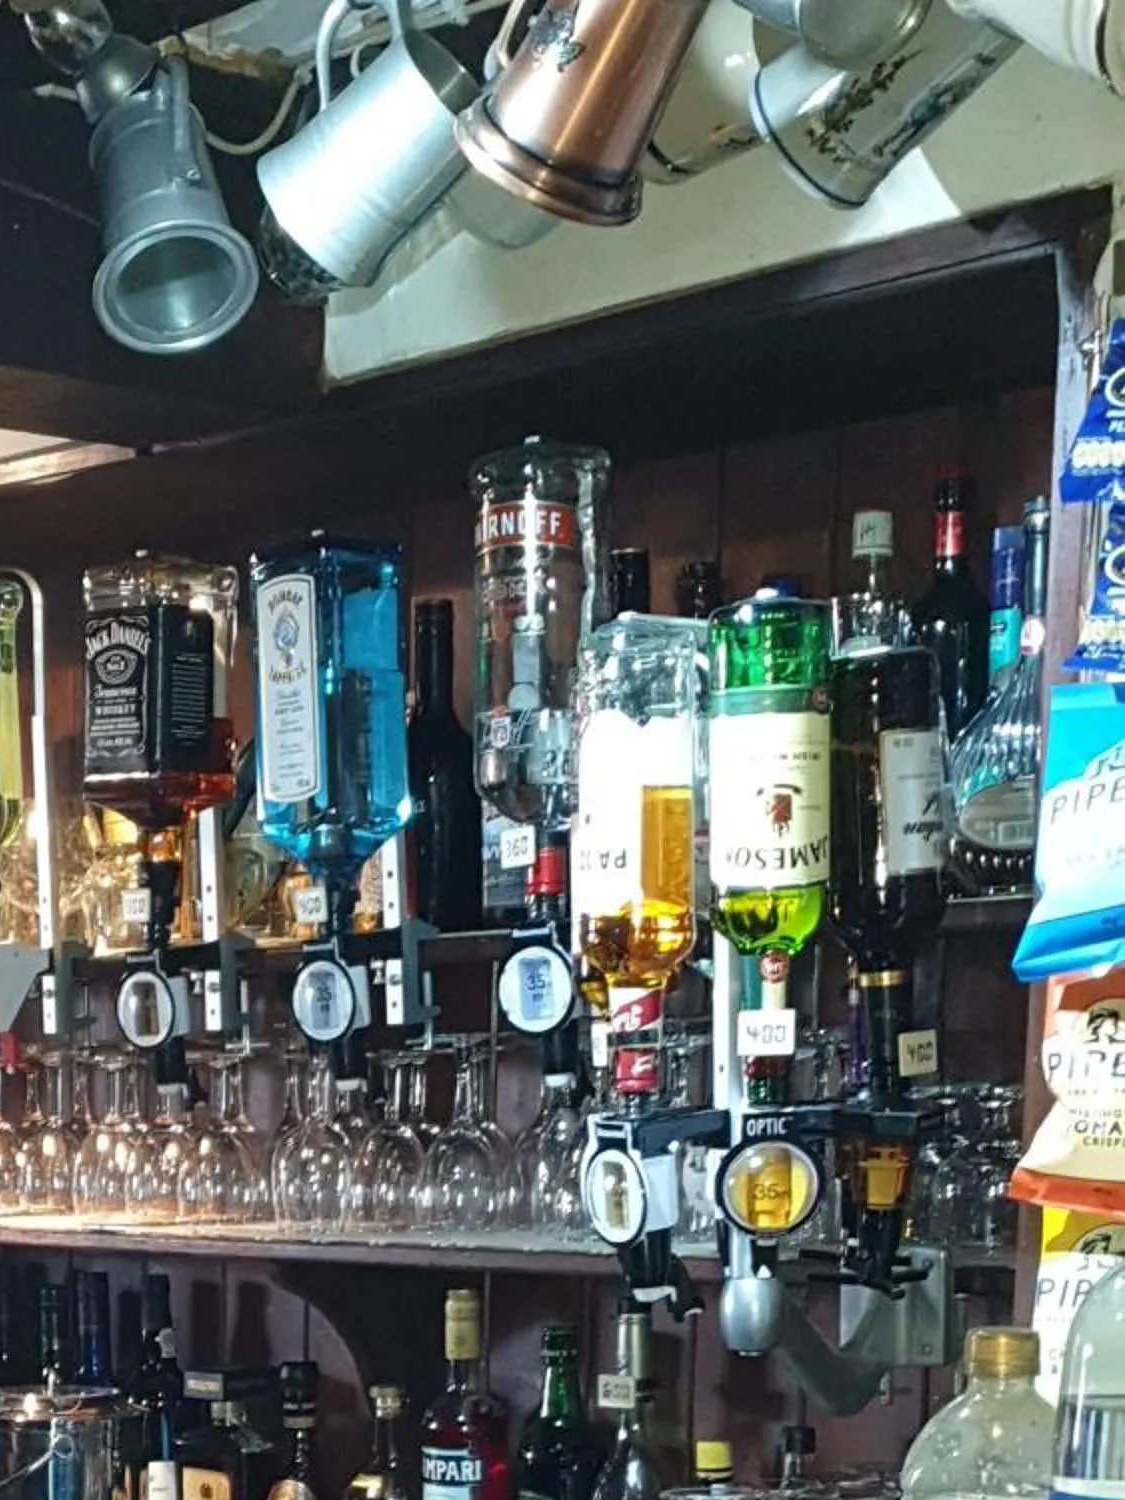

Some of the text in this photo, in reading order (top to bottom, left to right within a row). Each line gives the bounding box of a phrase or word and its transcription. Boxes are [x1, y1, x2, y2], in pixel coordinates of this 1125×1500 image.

[1050, 776, 1125, 825] PIPE
[1047, 1051, 1125, 1087] PIPE
[746, 1118, 789, 1136] OPTIC
[1036, 1277, 1093, 1309] PIP
[423, 1459, 483, 1481] MPARI
